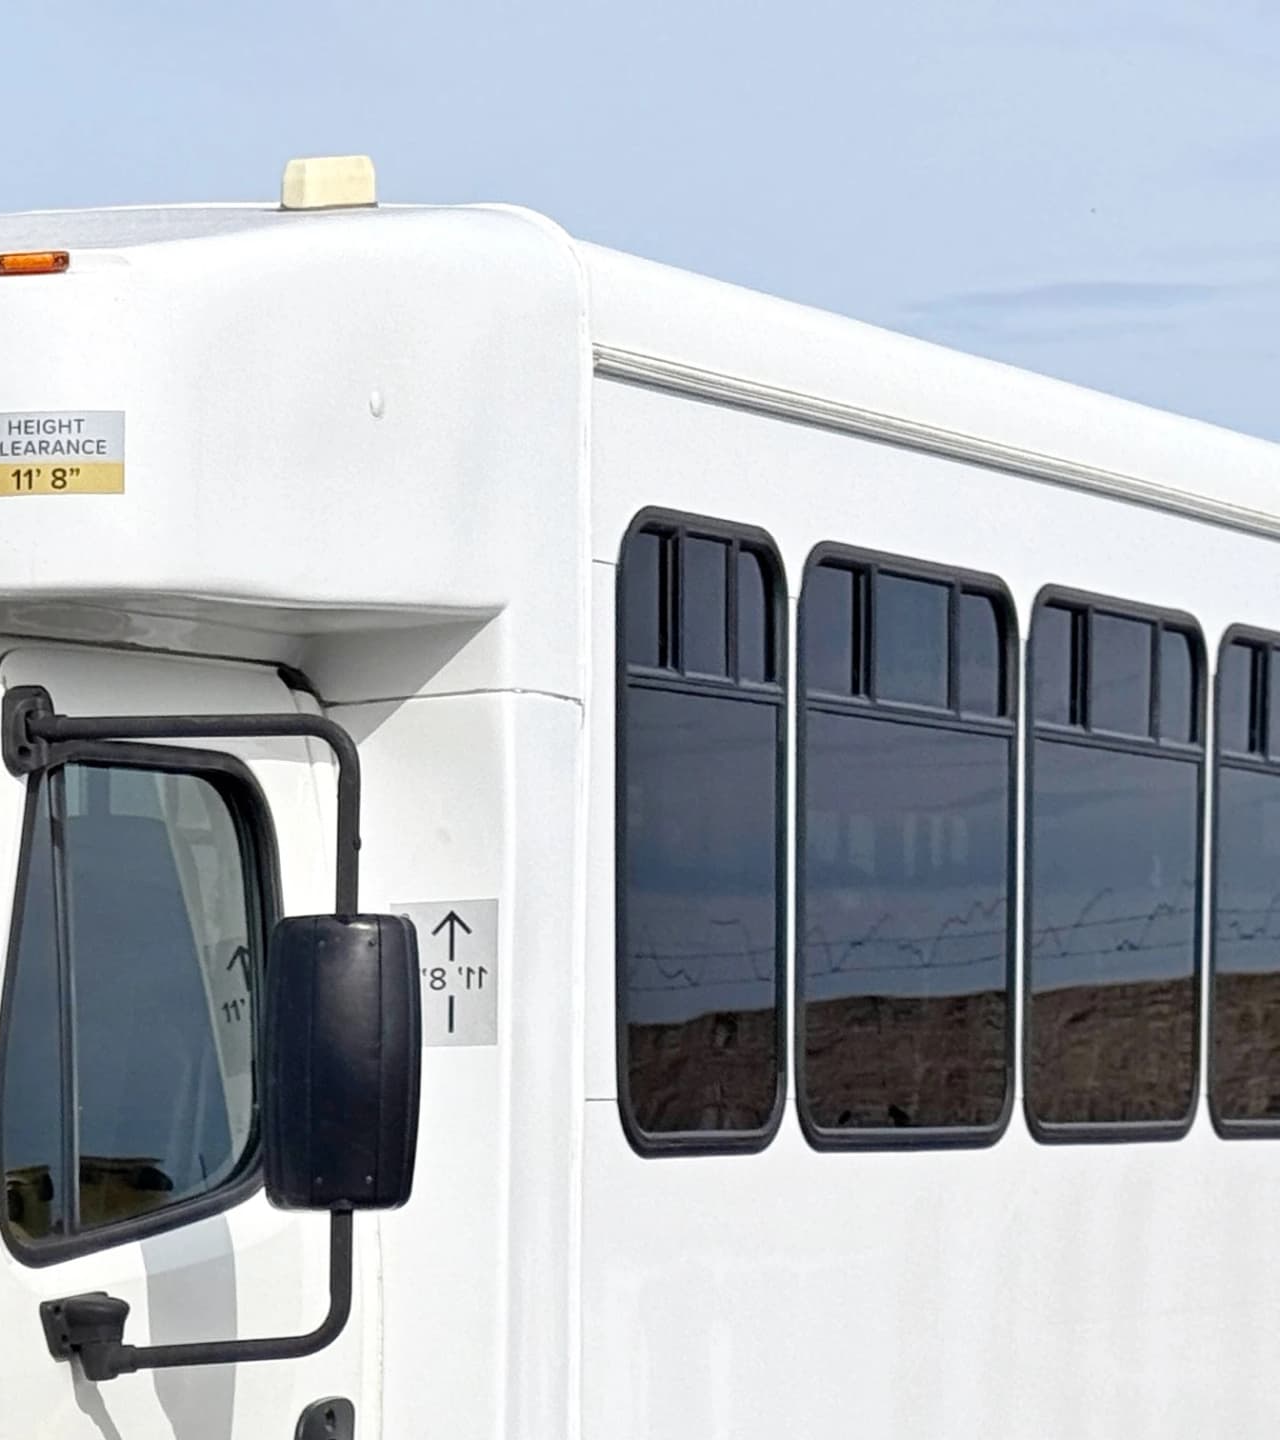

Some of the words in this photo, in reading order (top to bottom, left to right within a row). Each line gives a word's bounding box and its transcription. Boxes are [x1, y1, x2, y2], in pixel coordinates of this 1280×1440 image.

[8, 418, 86, 436] HEIGHT
[11, 468, 41, 490] 11'
[51, 467, 81, 490] 8"
